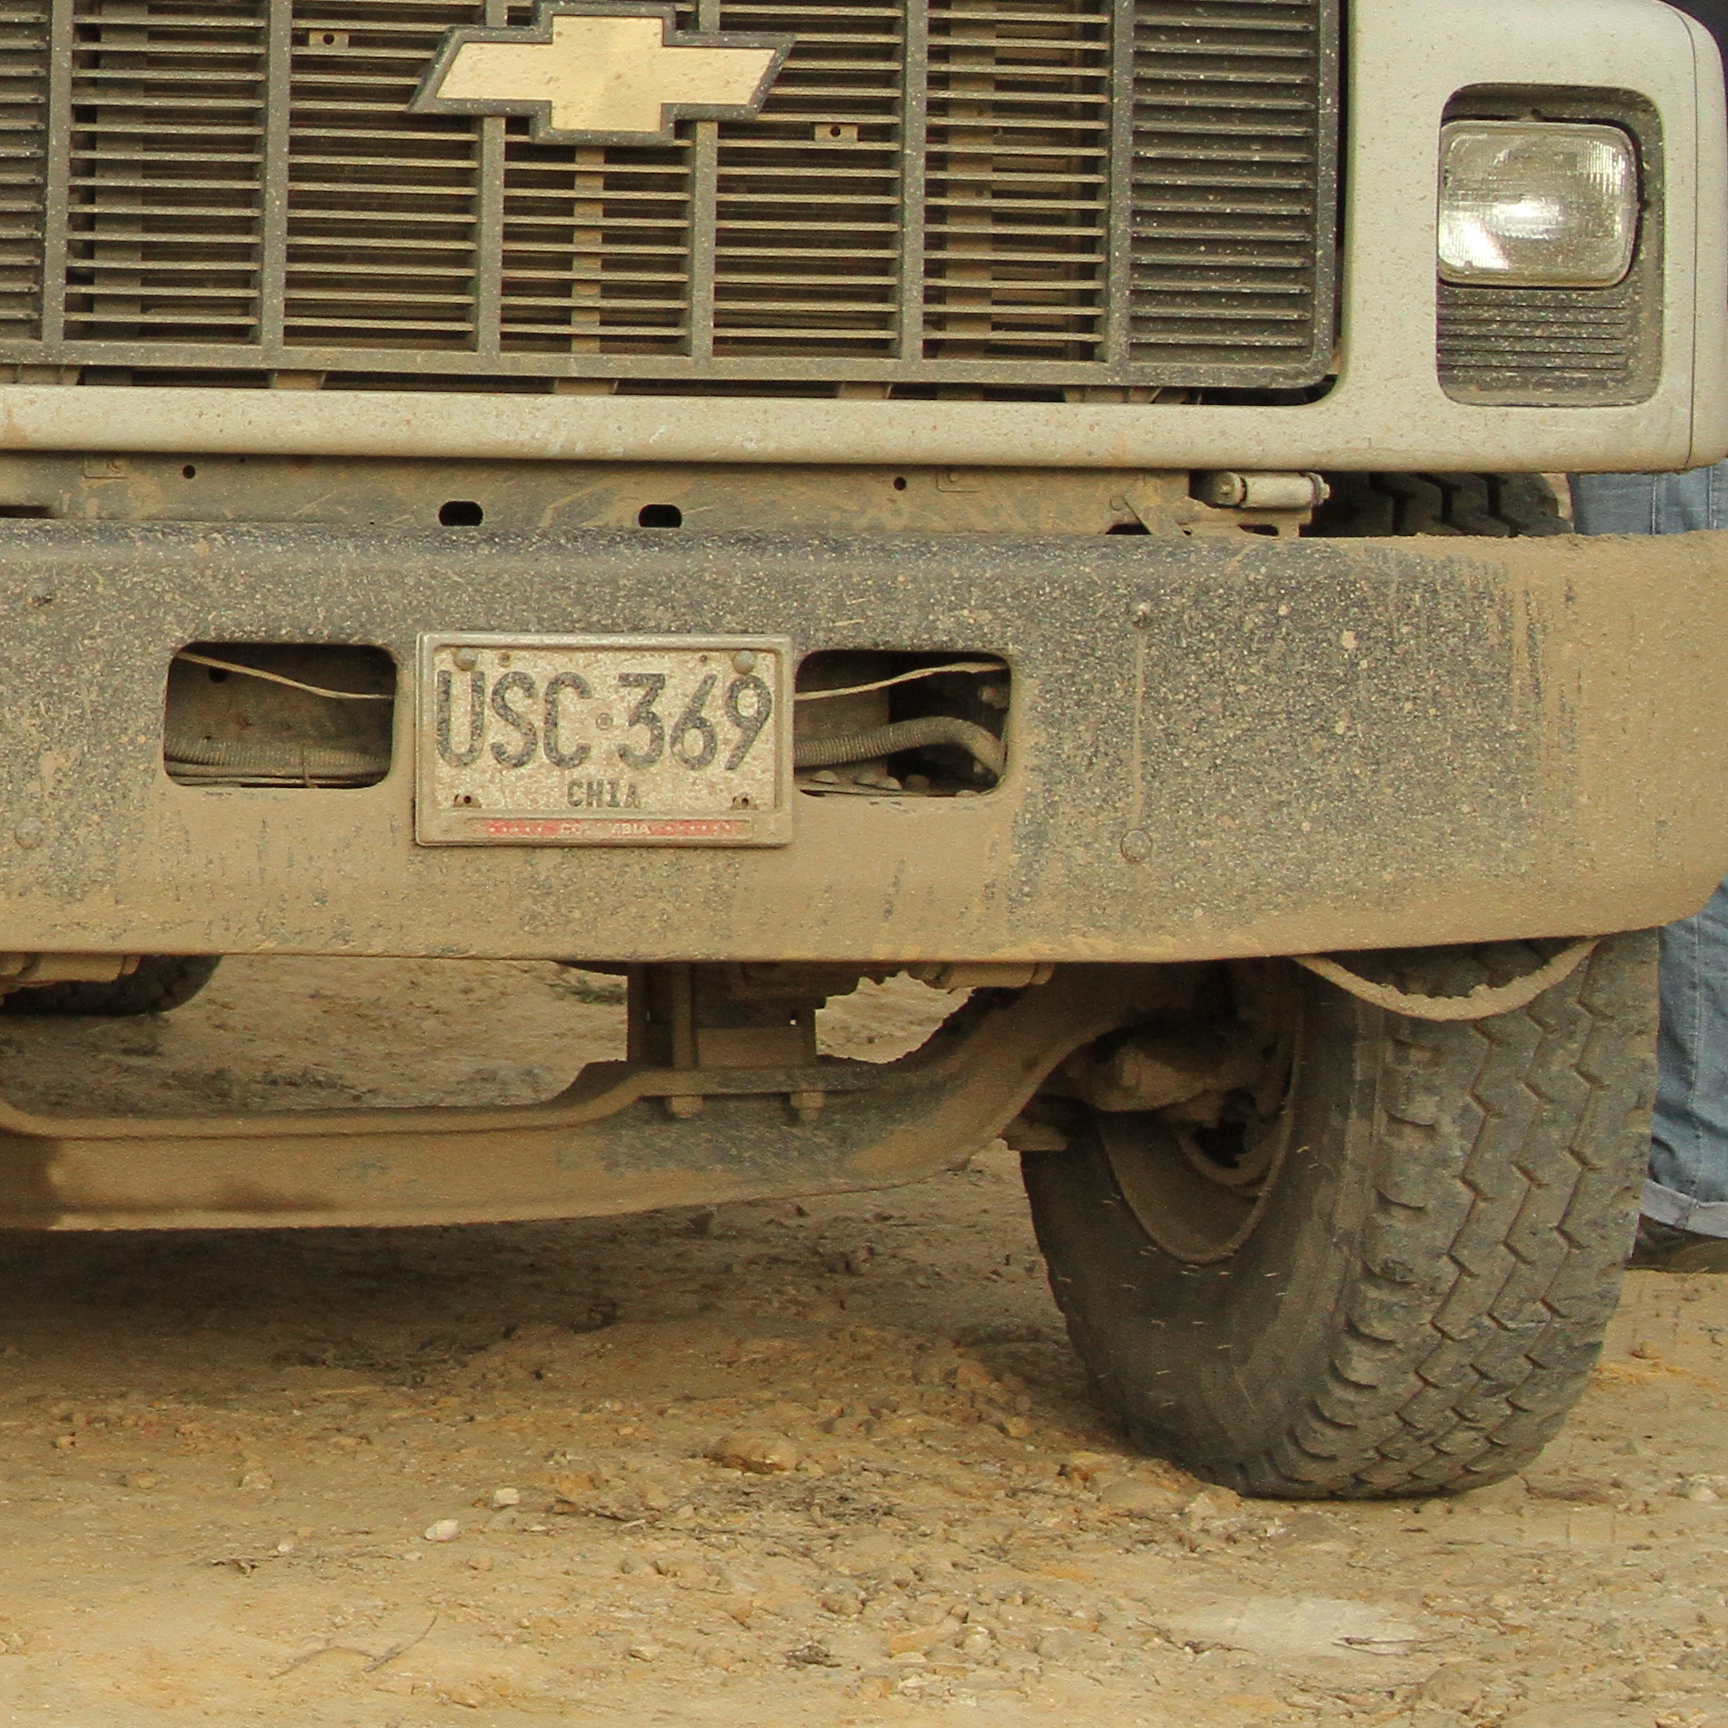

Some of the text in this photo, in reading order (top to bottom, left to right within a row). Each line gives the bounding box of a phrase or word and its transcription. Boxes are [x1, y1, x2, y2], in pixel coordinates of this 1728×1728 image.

[437, 669, 774, 771] USC 369
[566, 777, 641, 809] CHIA
